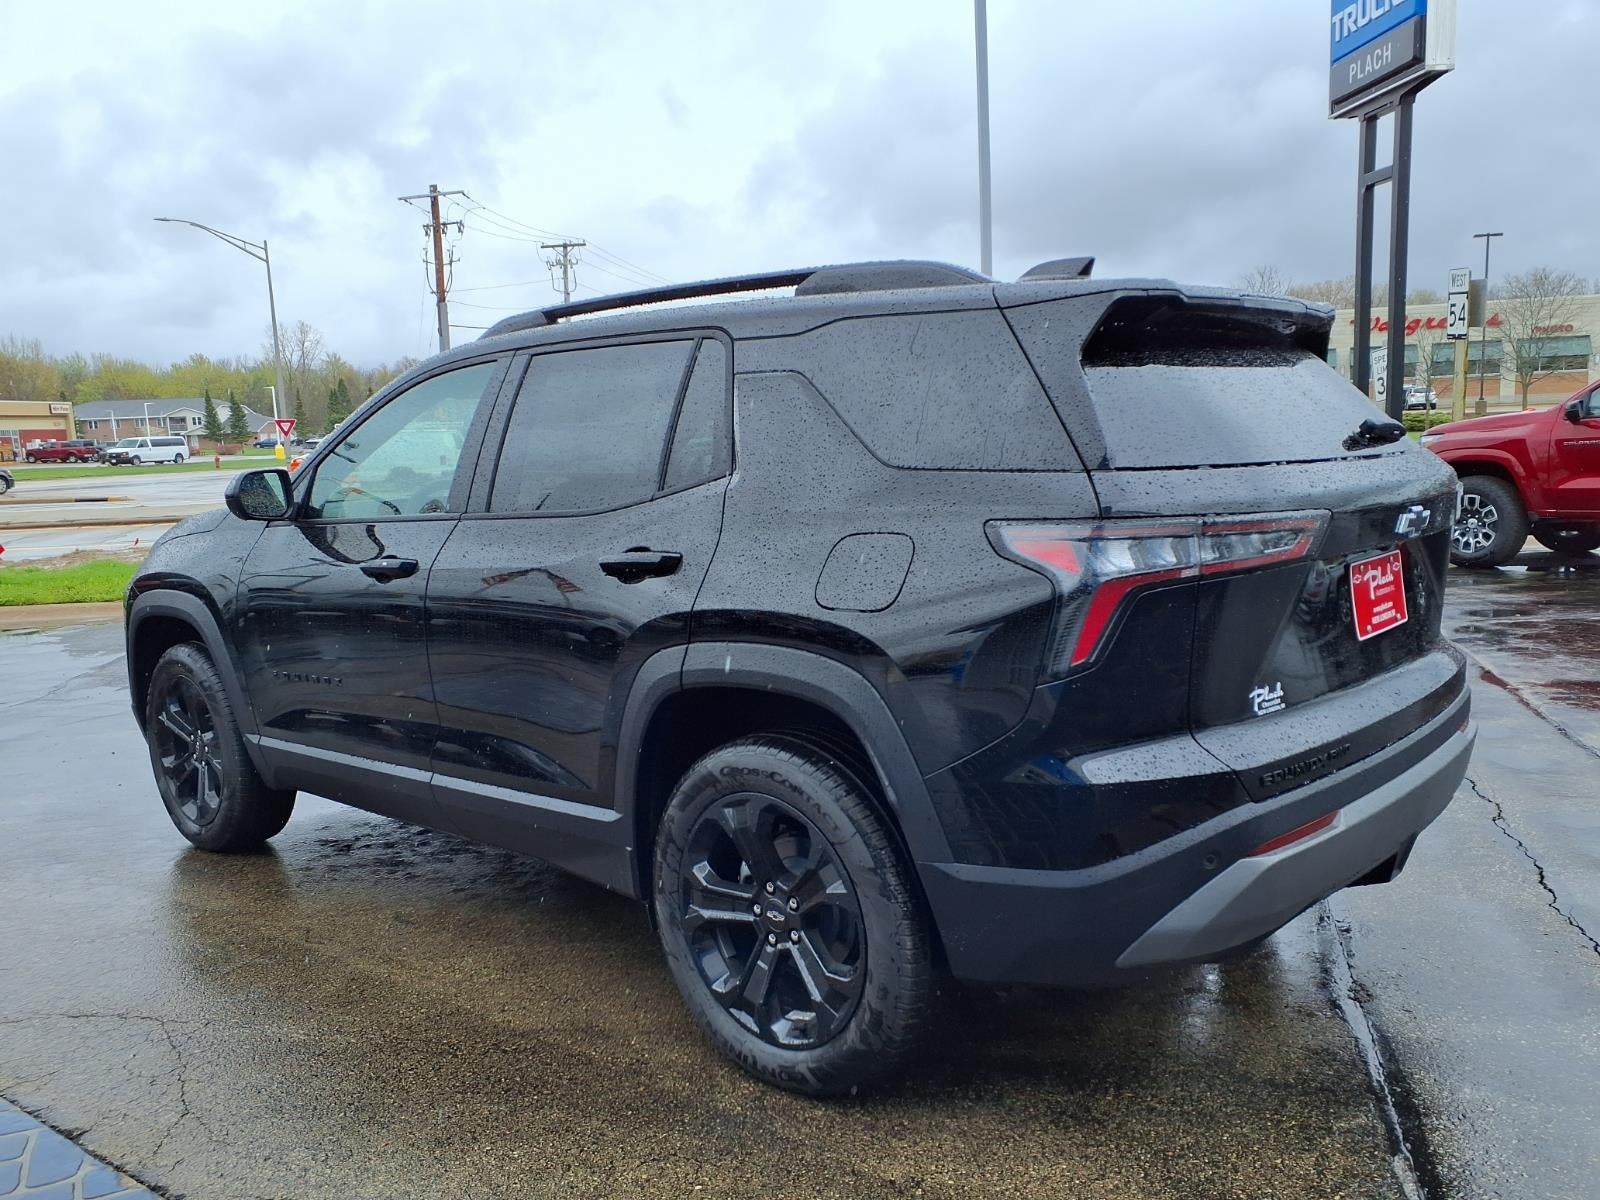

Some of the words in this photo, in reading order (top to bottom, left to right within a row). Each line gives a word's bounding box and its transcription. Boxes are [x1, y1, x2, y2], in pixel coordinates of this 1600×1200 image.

[1349, 42, 1392, 84] PLACH
[1451, 273, 1467, 288] WEST
[1449, 302, 1466, 328] 54
